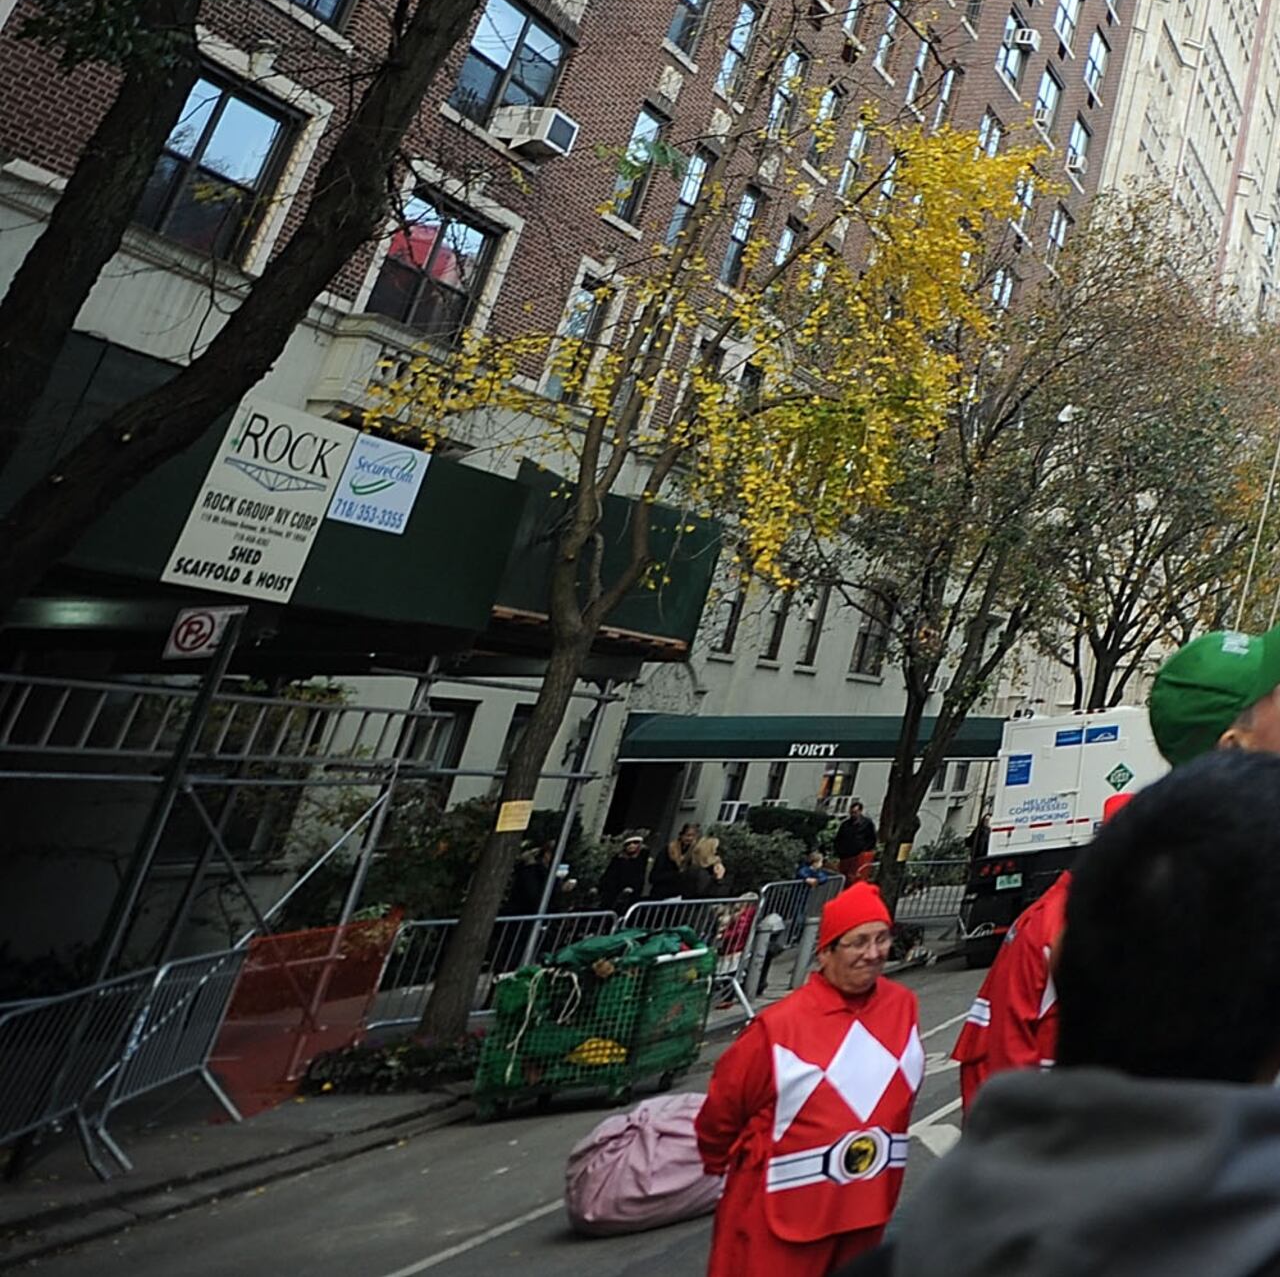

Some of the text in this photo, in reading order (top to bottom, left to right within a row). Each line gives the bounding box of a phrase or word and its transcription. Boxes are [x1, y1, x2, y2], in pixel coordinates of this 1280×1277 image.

[235, 412, 340, 480] ROCK
[202, 490, 238, 512] ROCK
[237, 498, 277, 522] GROUP
[274, 506, 291, 525] NY
[290, 510, 319, 532] CORP
[228, 545, 263, 565] SHED
[173, 556, 294, 592] SCAFFOLD & HOIST
[788, 743, 840, 757] FORTY
[1009, 802, 1069, 815] COMPRESSED
[1022, 796, 1058, 806] HELIUM
[1014, 811, 1070, 824] NO SMOKING
